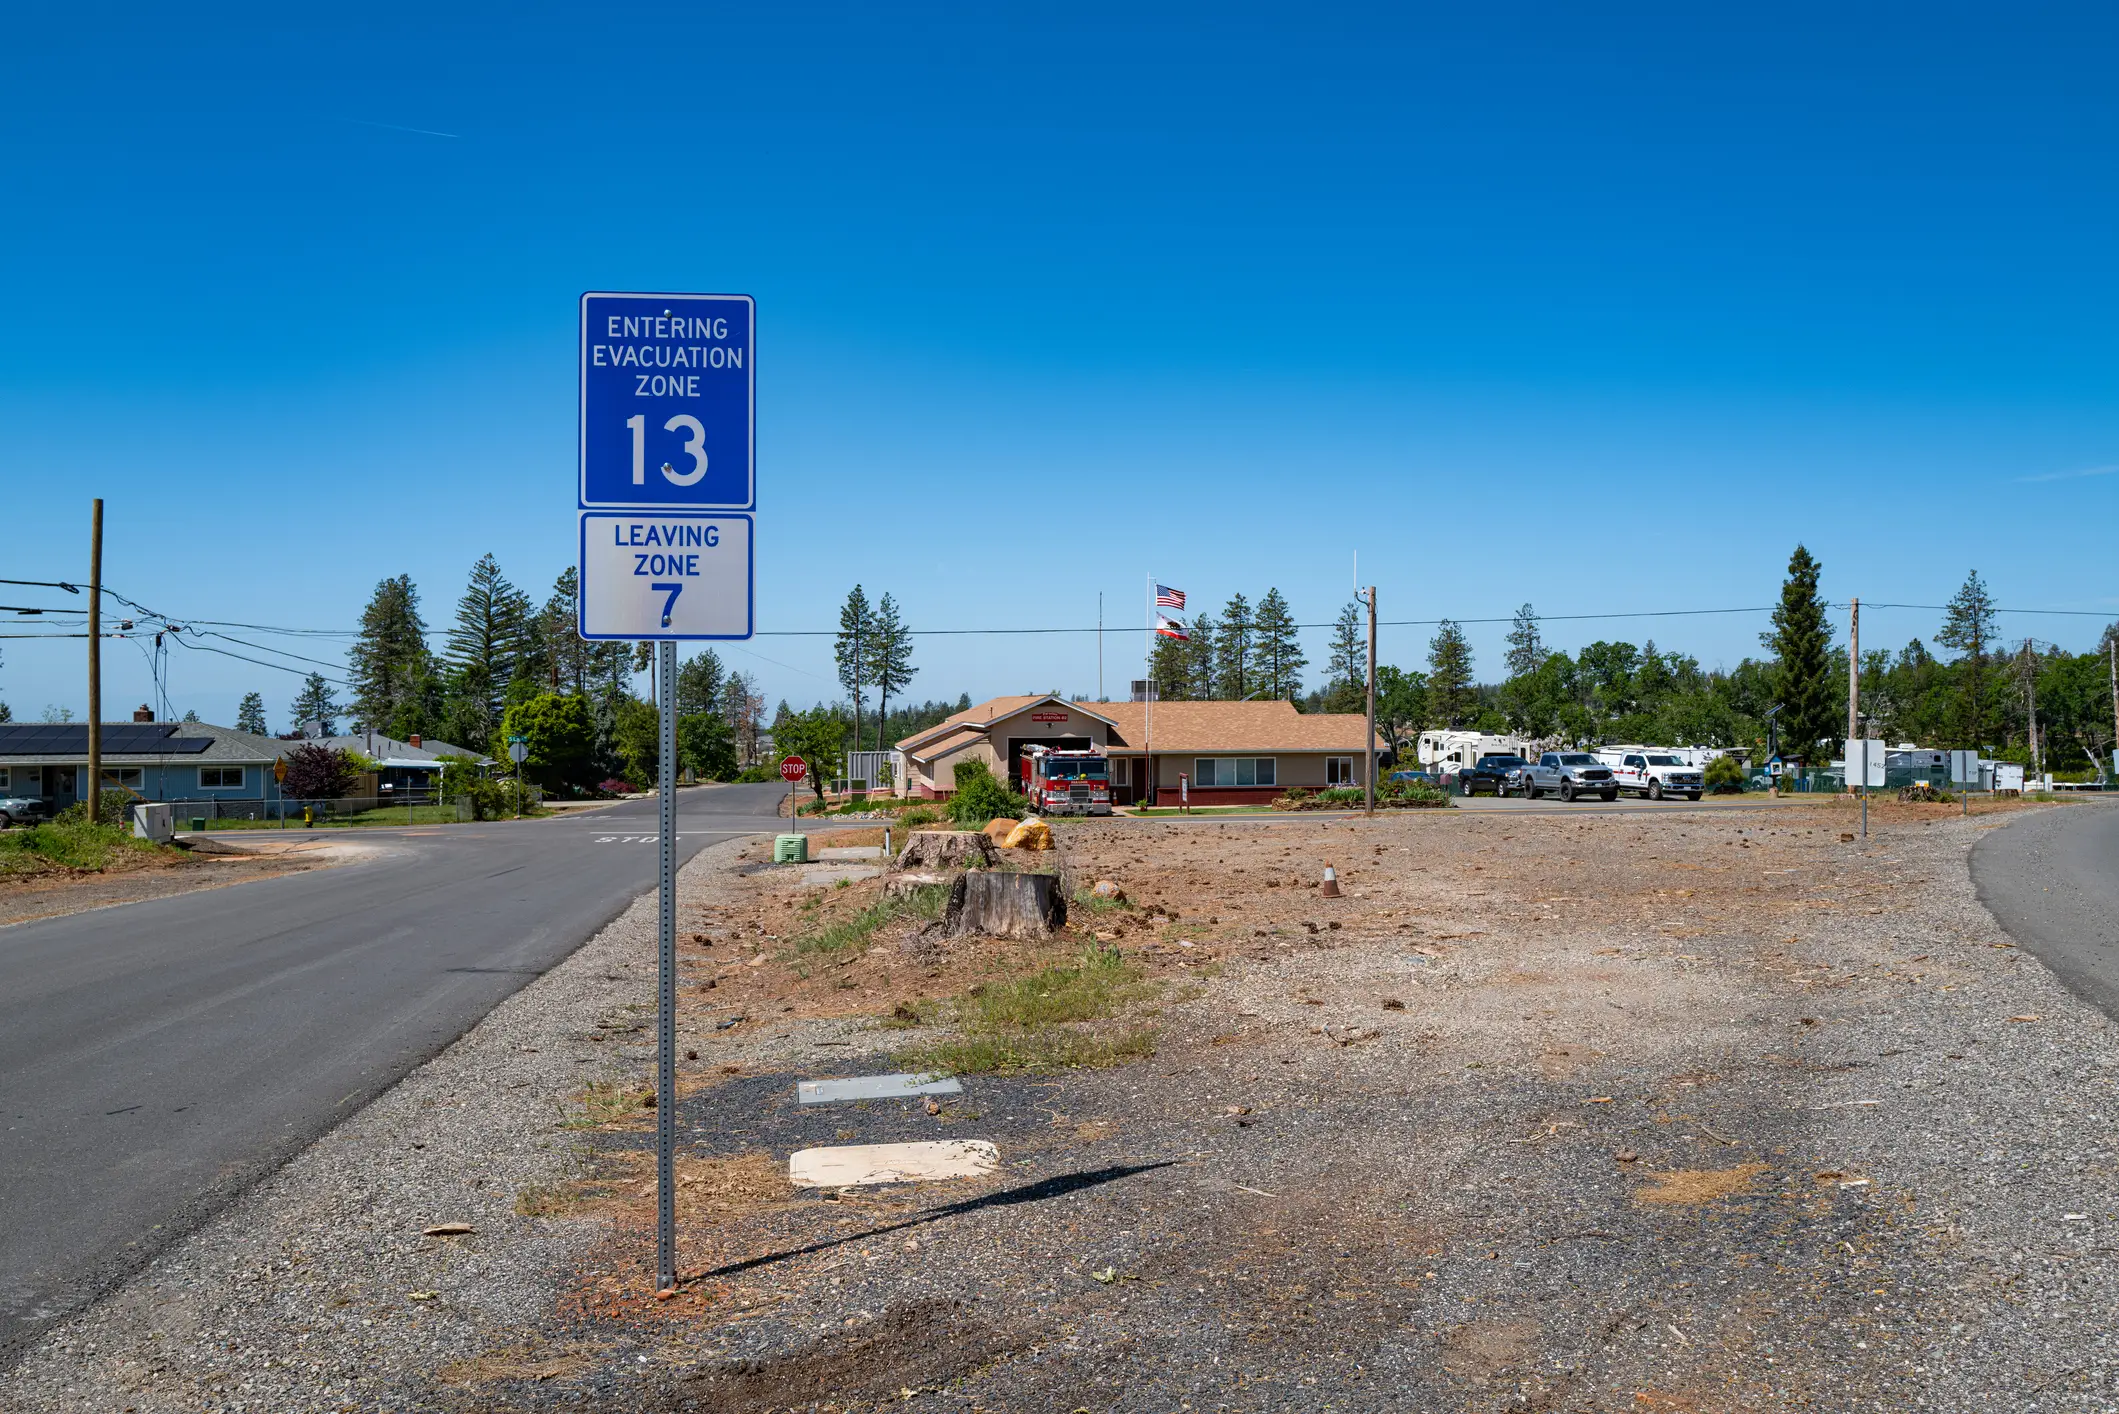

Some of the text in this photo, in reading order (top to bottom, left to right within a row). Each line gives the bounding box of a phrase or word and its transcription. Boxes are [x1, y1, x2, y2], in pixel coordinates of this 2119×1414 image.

[608, 316, 728, 340] ENTERING
[593, 345, 742, 369] EVACUATION
[635, 375, 701, 397] ZONE
[626, 414, 708, 487] 13
[615, 525, 720, 548] LEAVING
[634, 554, 700, 576] ZONE
[651, 583, 683, 628] 7
[782, 763, 805, 774] STOP
